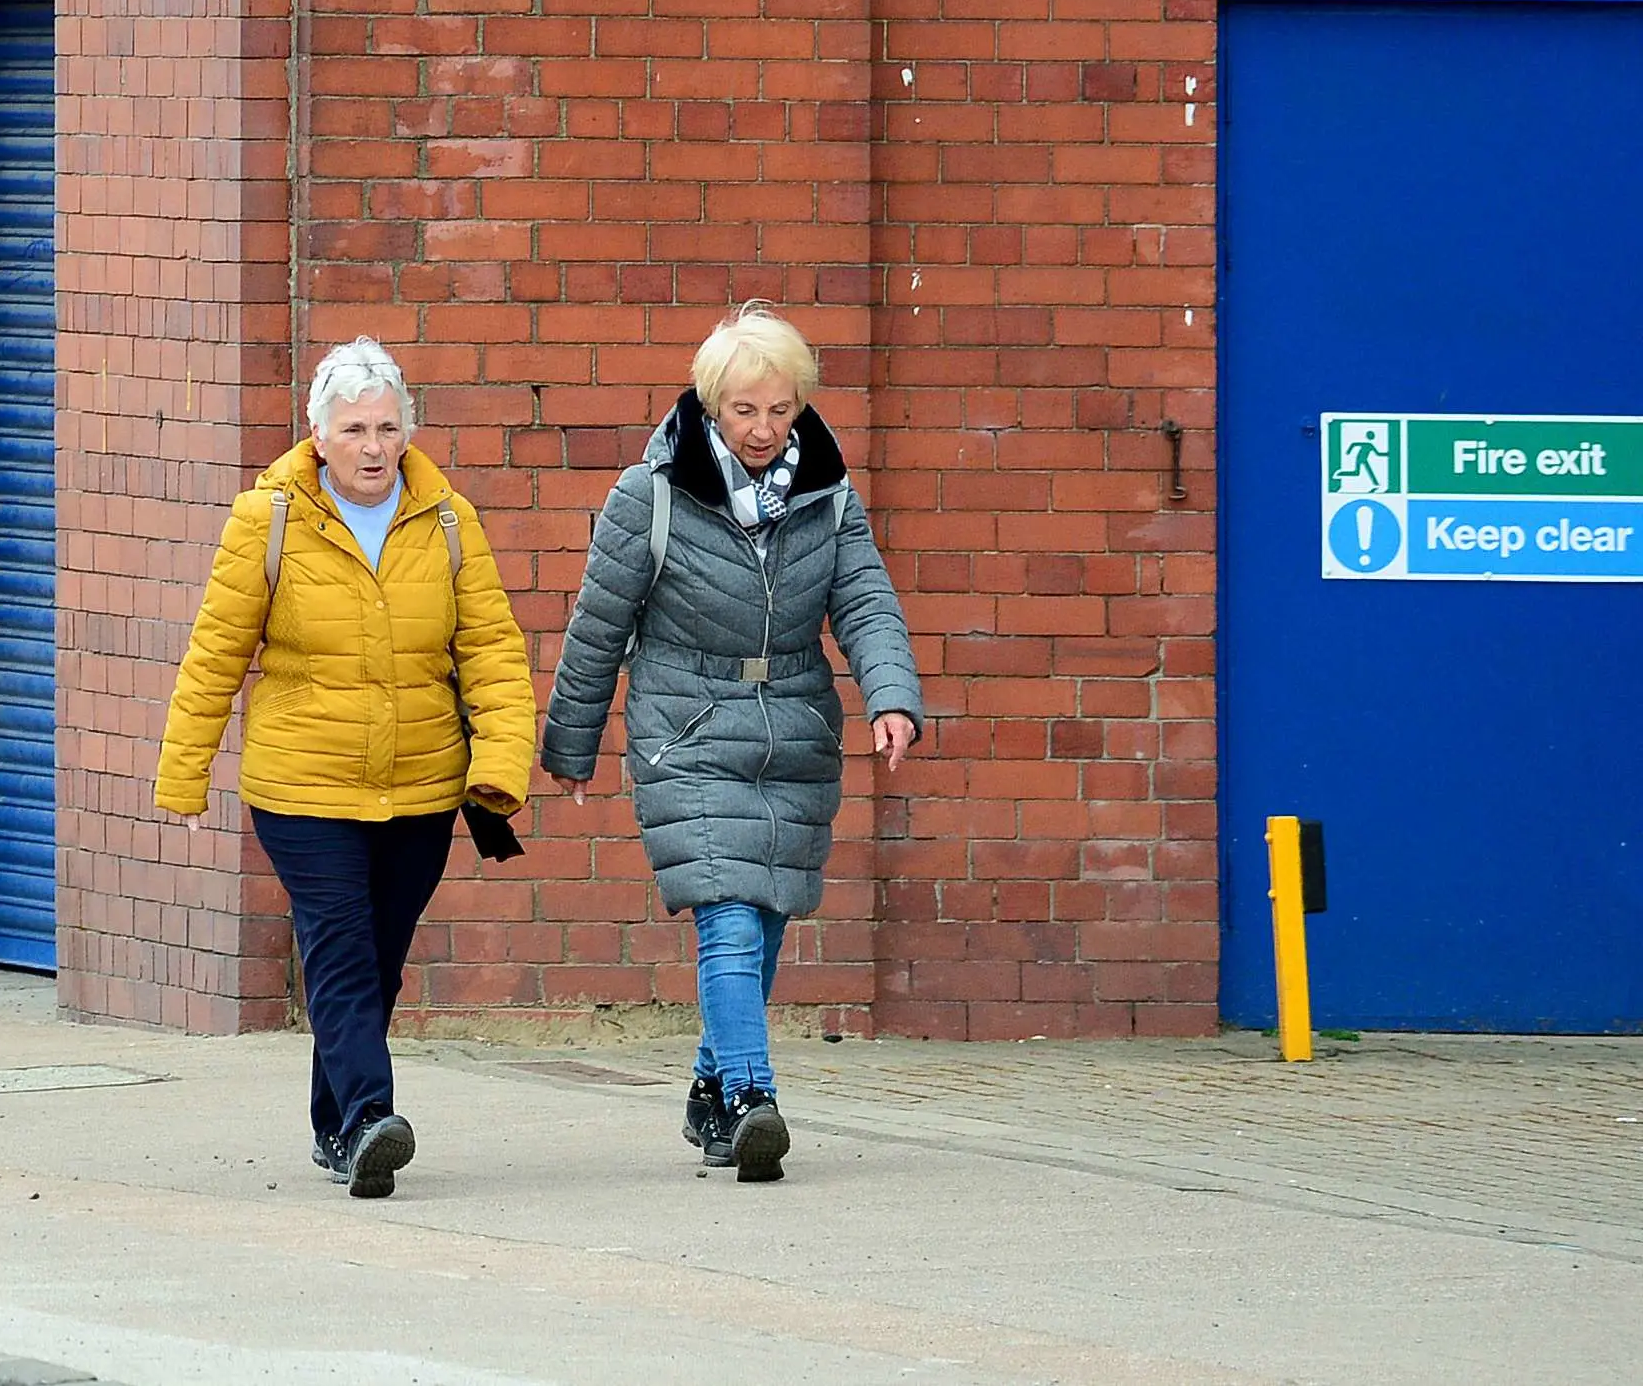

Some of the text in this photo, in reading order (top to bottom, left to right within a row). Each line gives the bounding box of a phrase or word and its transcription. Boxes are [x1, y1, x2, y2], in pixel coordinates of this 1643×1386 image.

[1453, 440, 1608, 476] Fire exit
[1427, 516, 1634, 558] Keep clear
